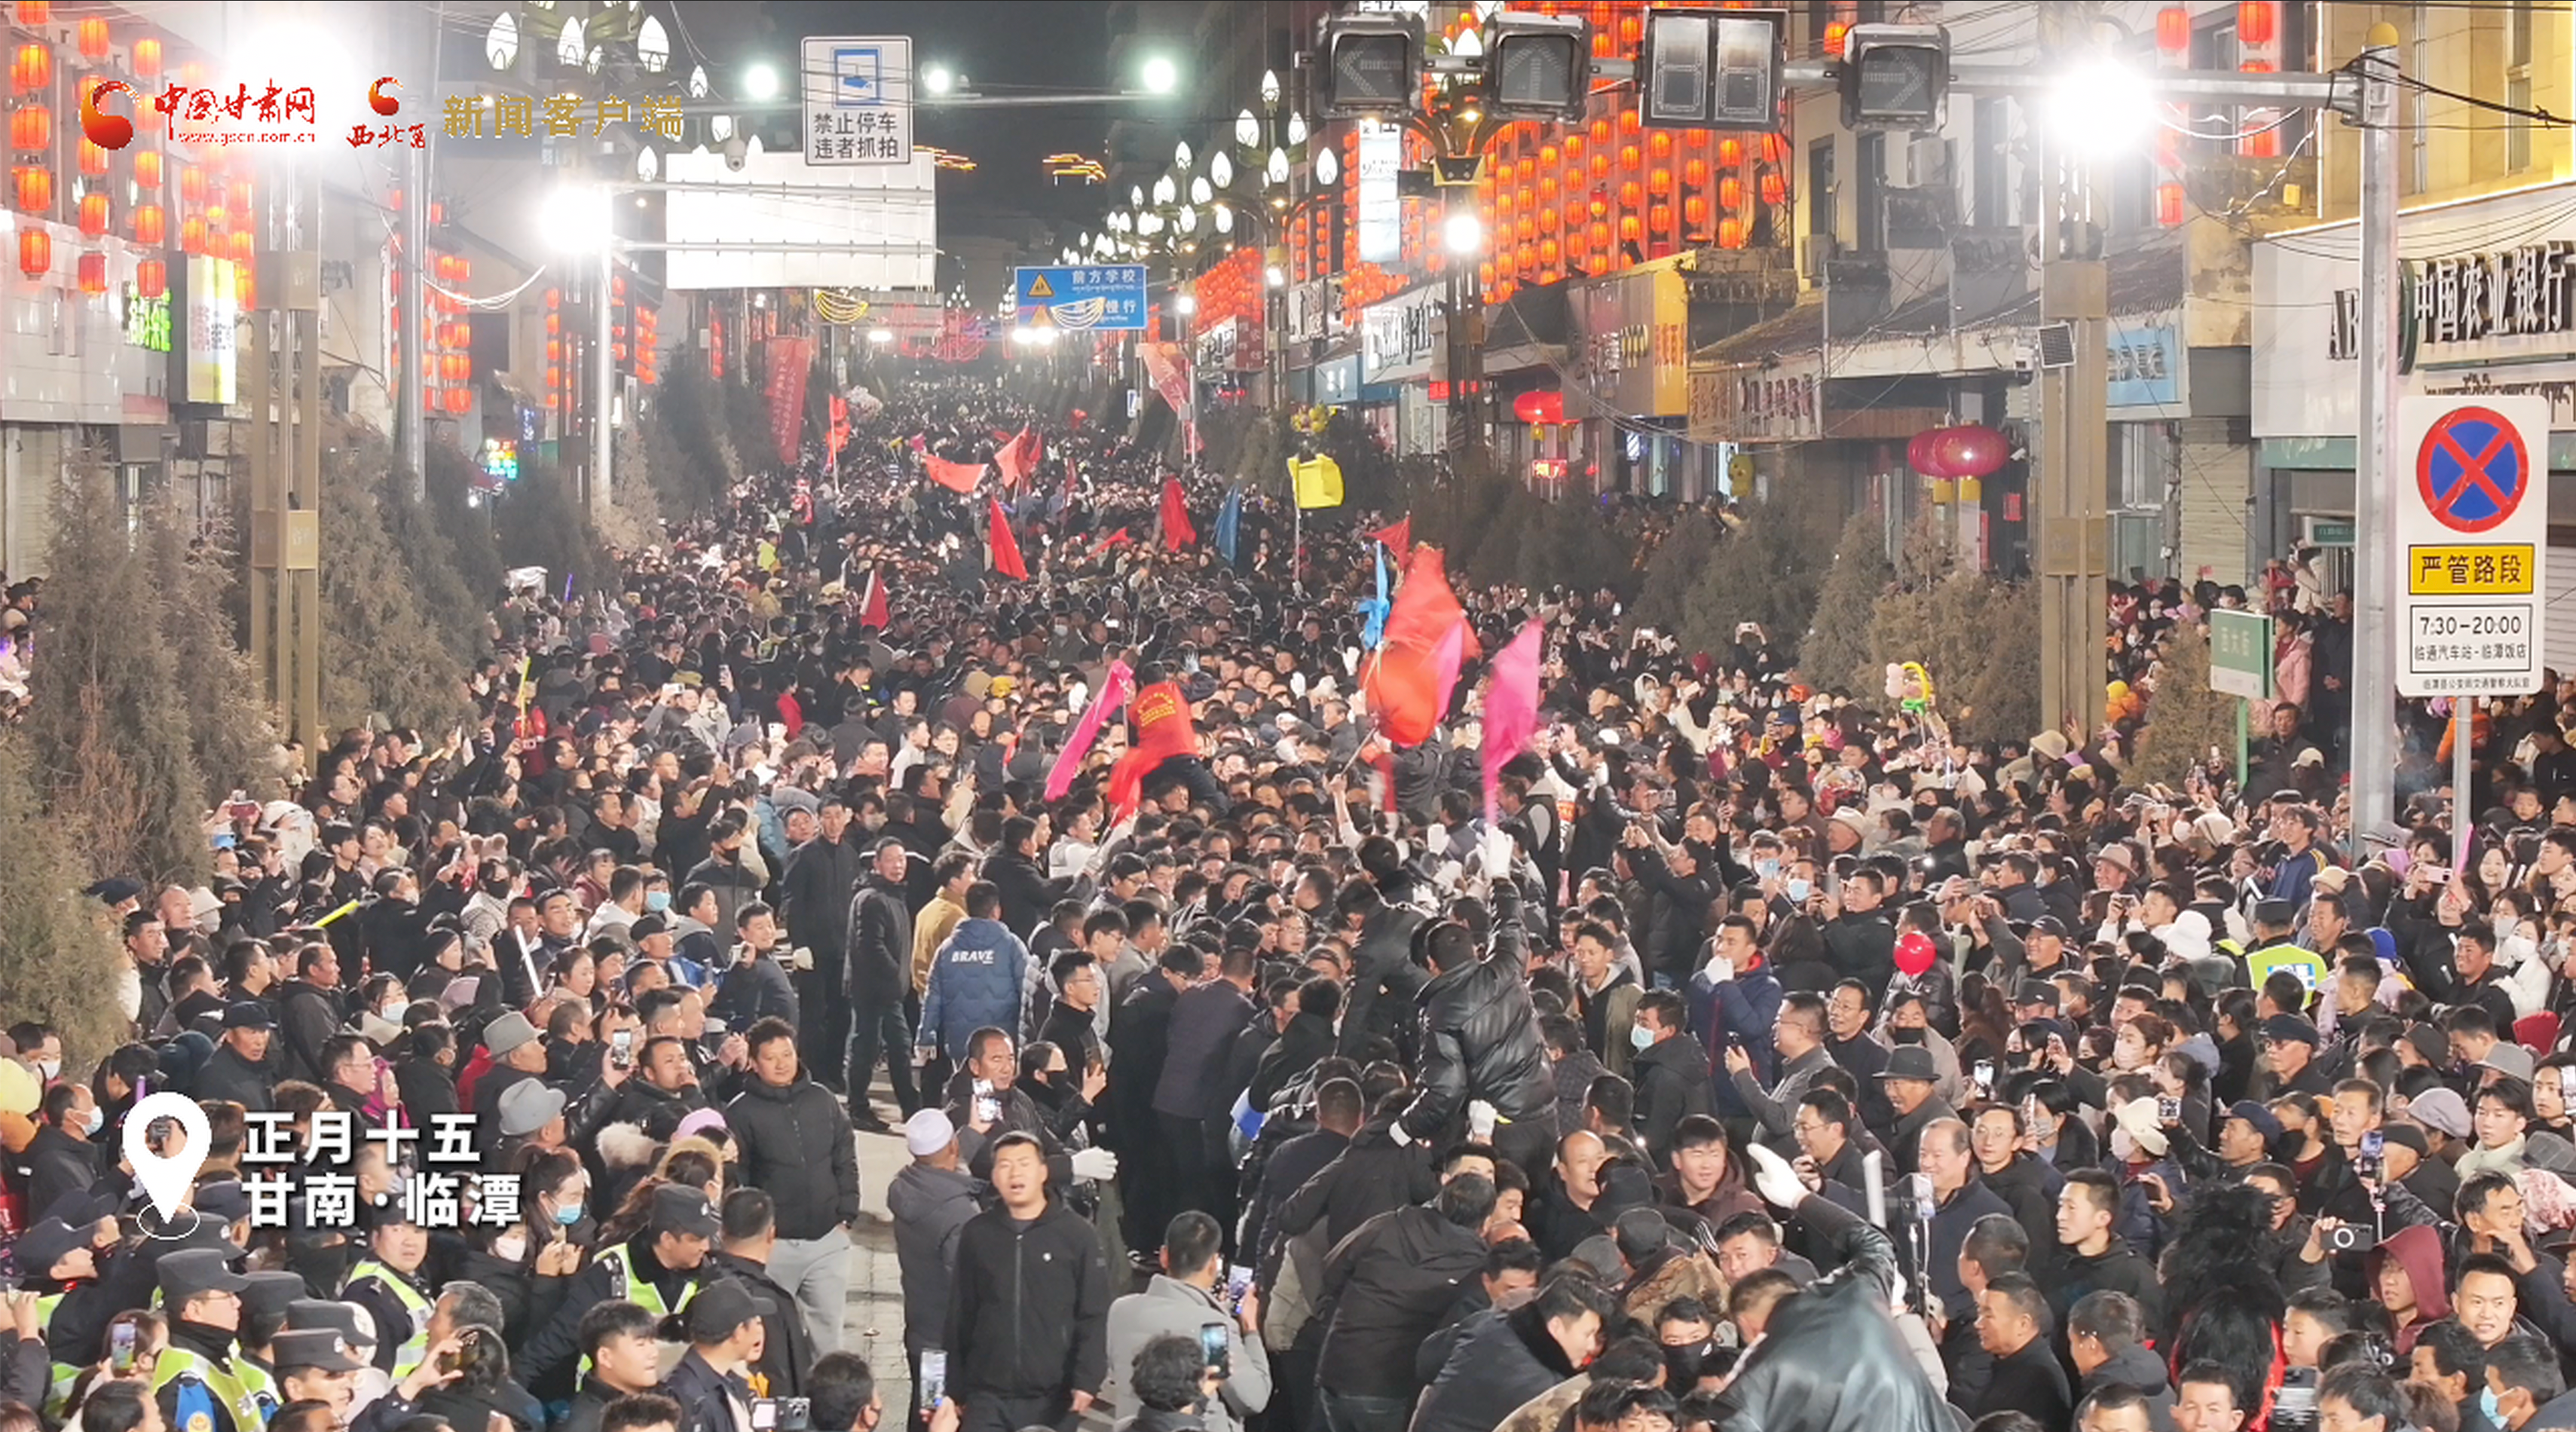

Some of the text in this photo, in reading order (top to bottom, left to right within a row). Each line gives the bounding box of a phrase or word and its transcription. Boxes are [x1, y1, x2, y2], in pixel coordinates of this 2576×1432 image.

[815, 112, 898, 135] 禁止停车
[815, 136, 898, 158] 违者抓拍
[1072, 268, 1137, 286] 前方学校
[2414, 241, 2566, 344] 中国农业银行
[2420, 555, 2522, 584] 严管路段
[2420, 616, 2521, 635] 7:30-20:00
[951, 950, 994, 963] BRAVE
